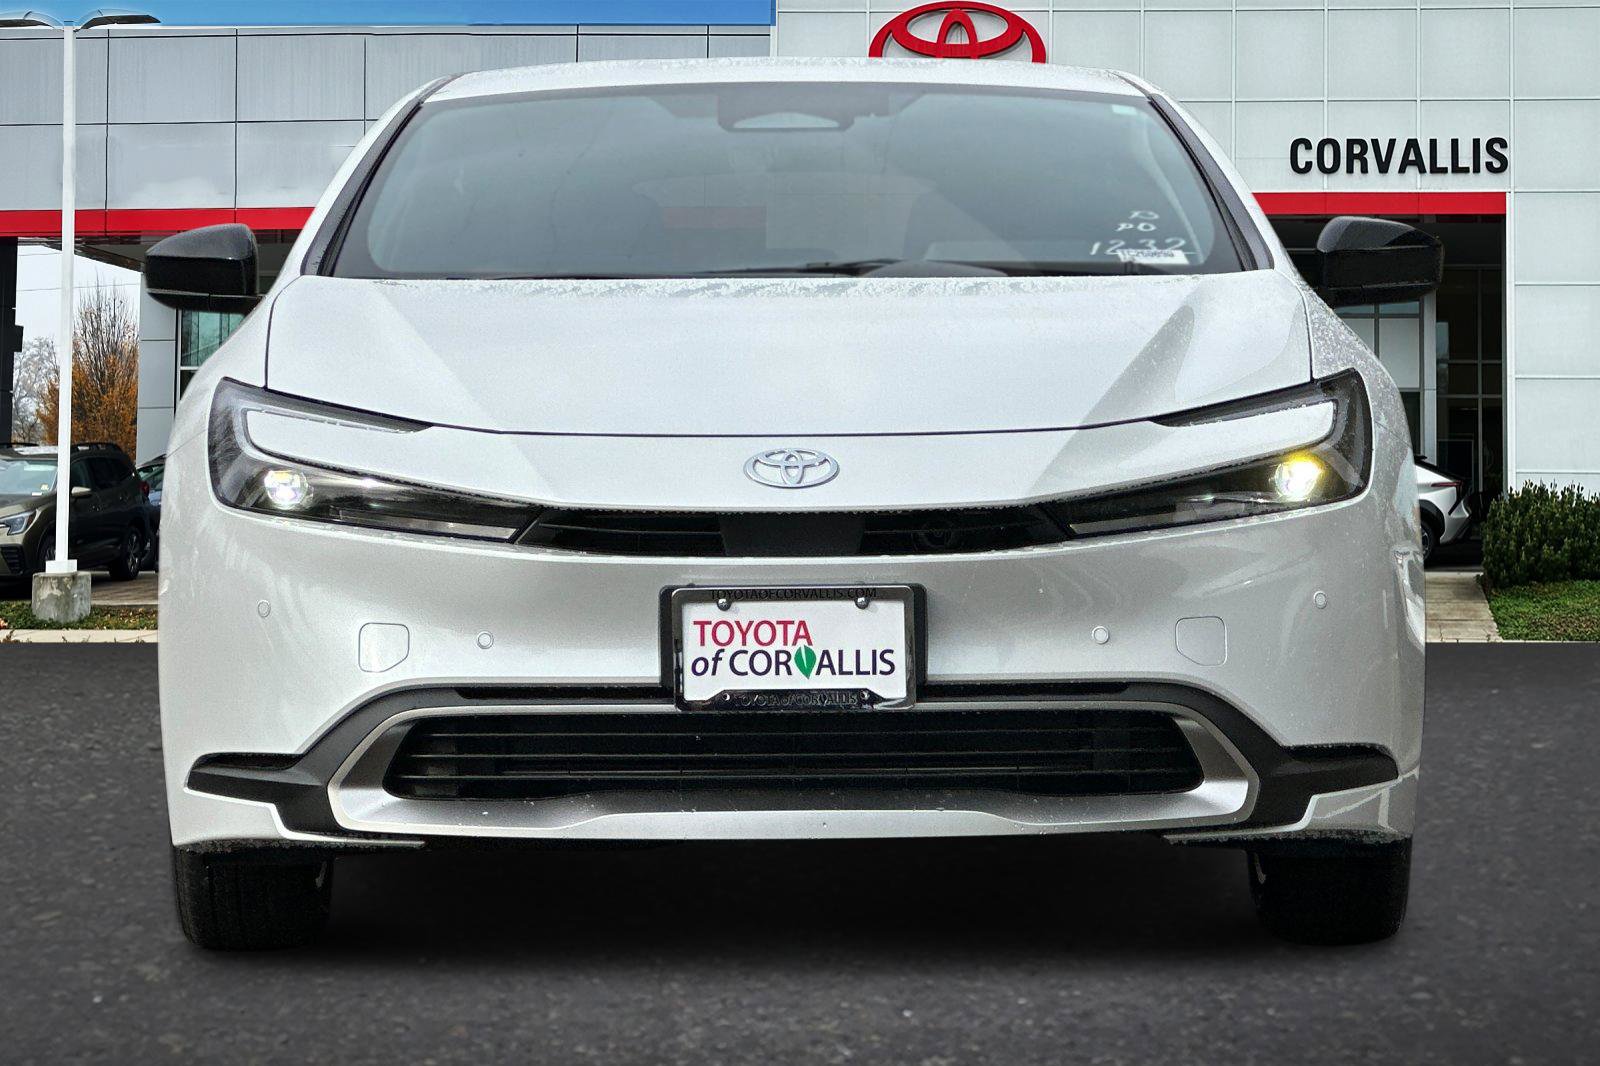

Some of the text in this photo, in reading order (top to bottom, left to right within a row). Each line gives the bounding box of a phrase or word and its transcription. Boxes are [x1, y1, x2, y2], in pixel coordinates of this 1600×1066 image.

[1289, 137, 1509, 175] CORVALLIS
[692, 619, 814, 647] TOYOTA
[690, 648, 725, 677] of
